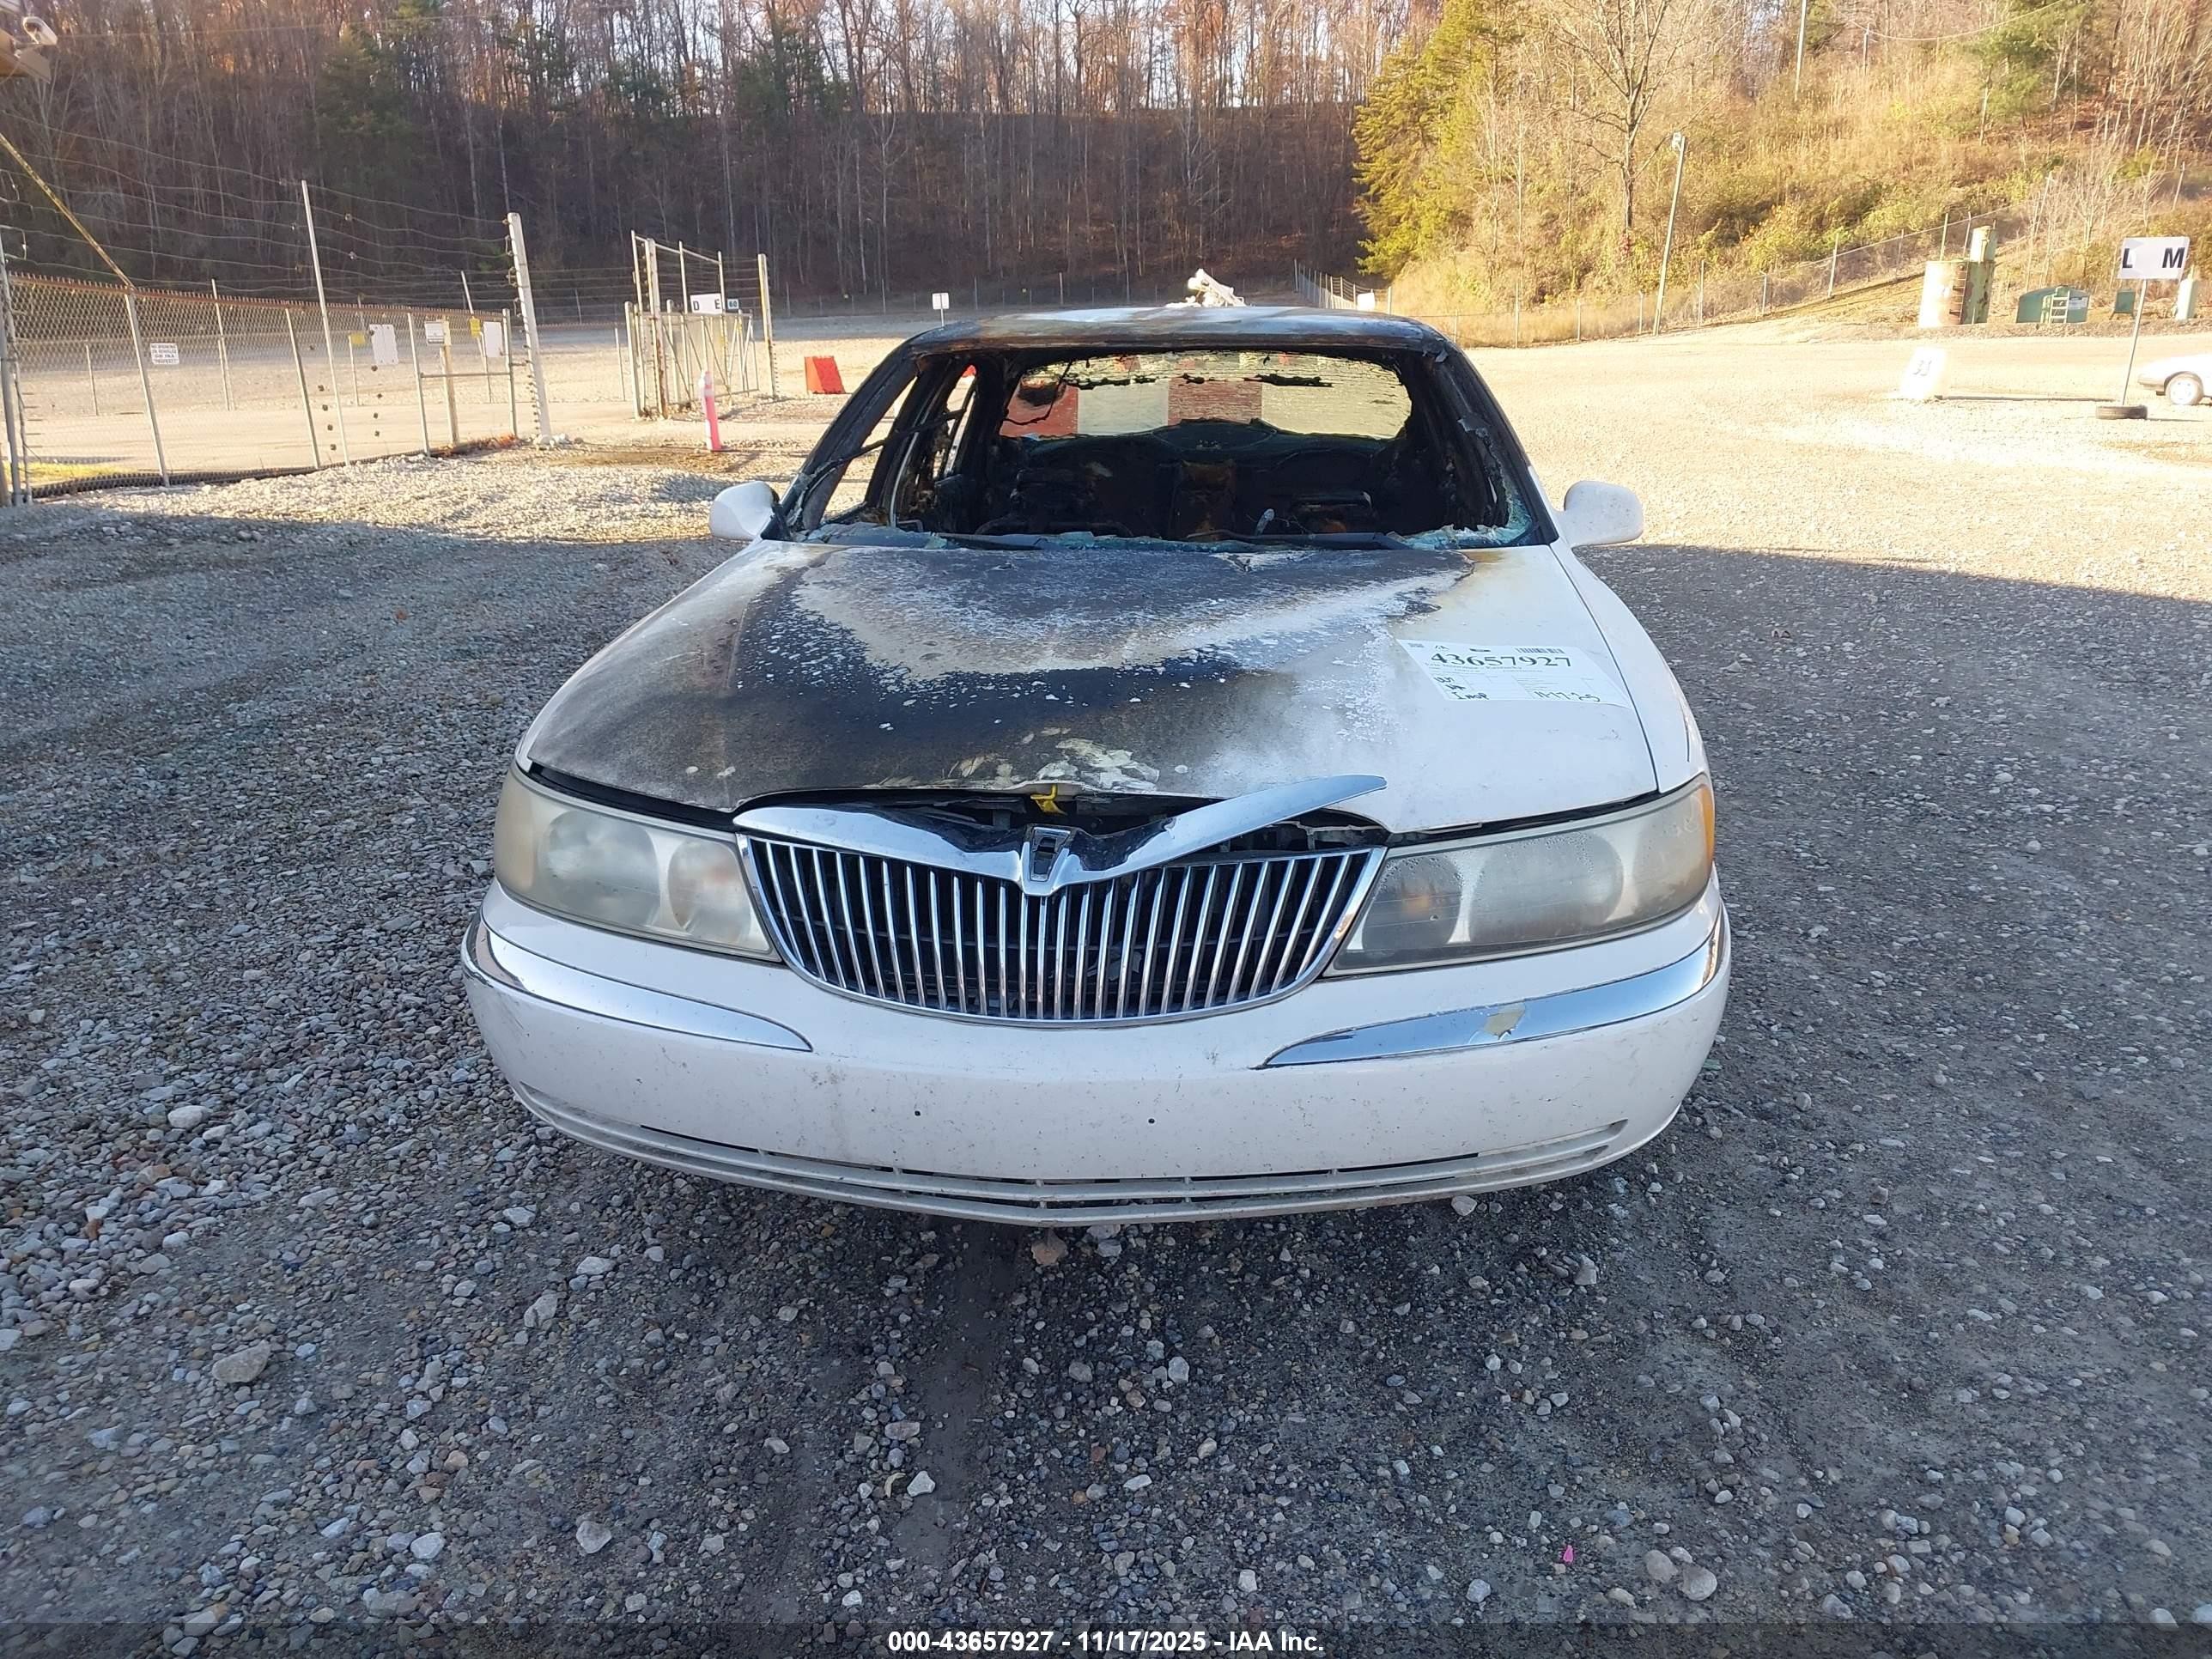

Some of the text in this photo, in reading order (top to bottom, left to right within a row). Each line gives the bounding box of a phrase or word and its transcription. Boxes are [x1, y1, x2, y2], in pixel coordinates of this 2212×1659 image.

[2122, 247, 2185, 268] L M
[693, 299, 720, 311] D E
[1431, 653, 1571, 667] 43657927
